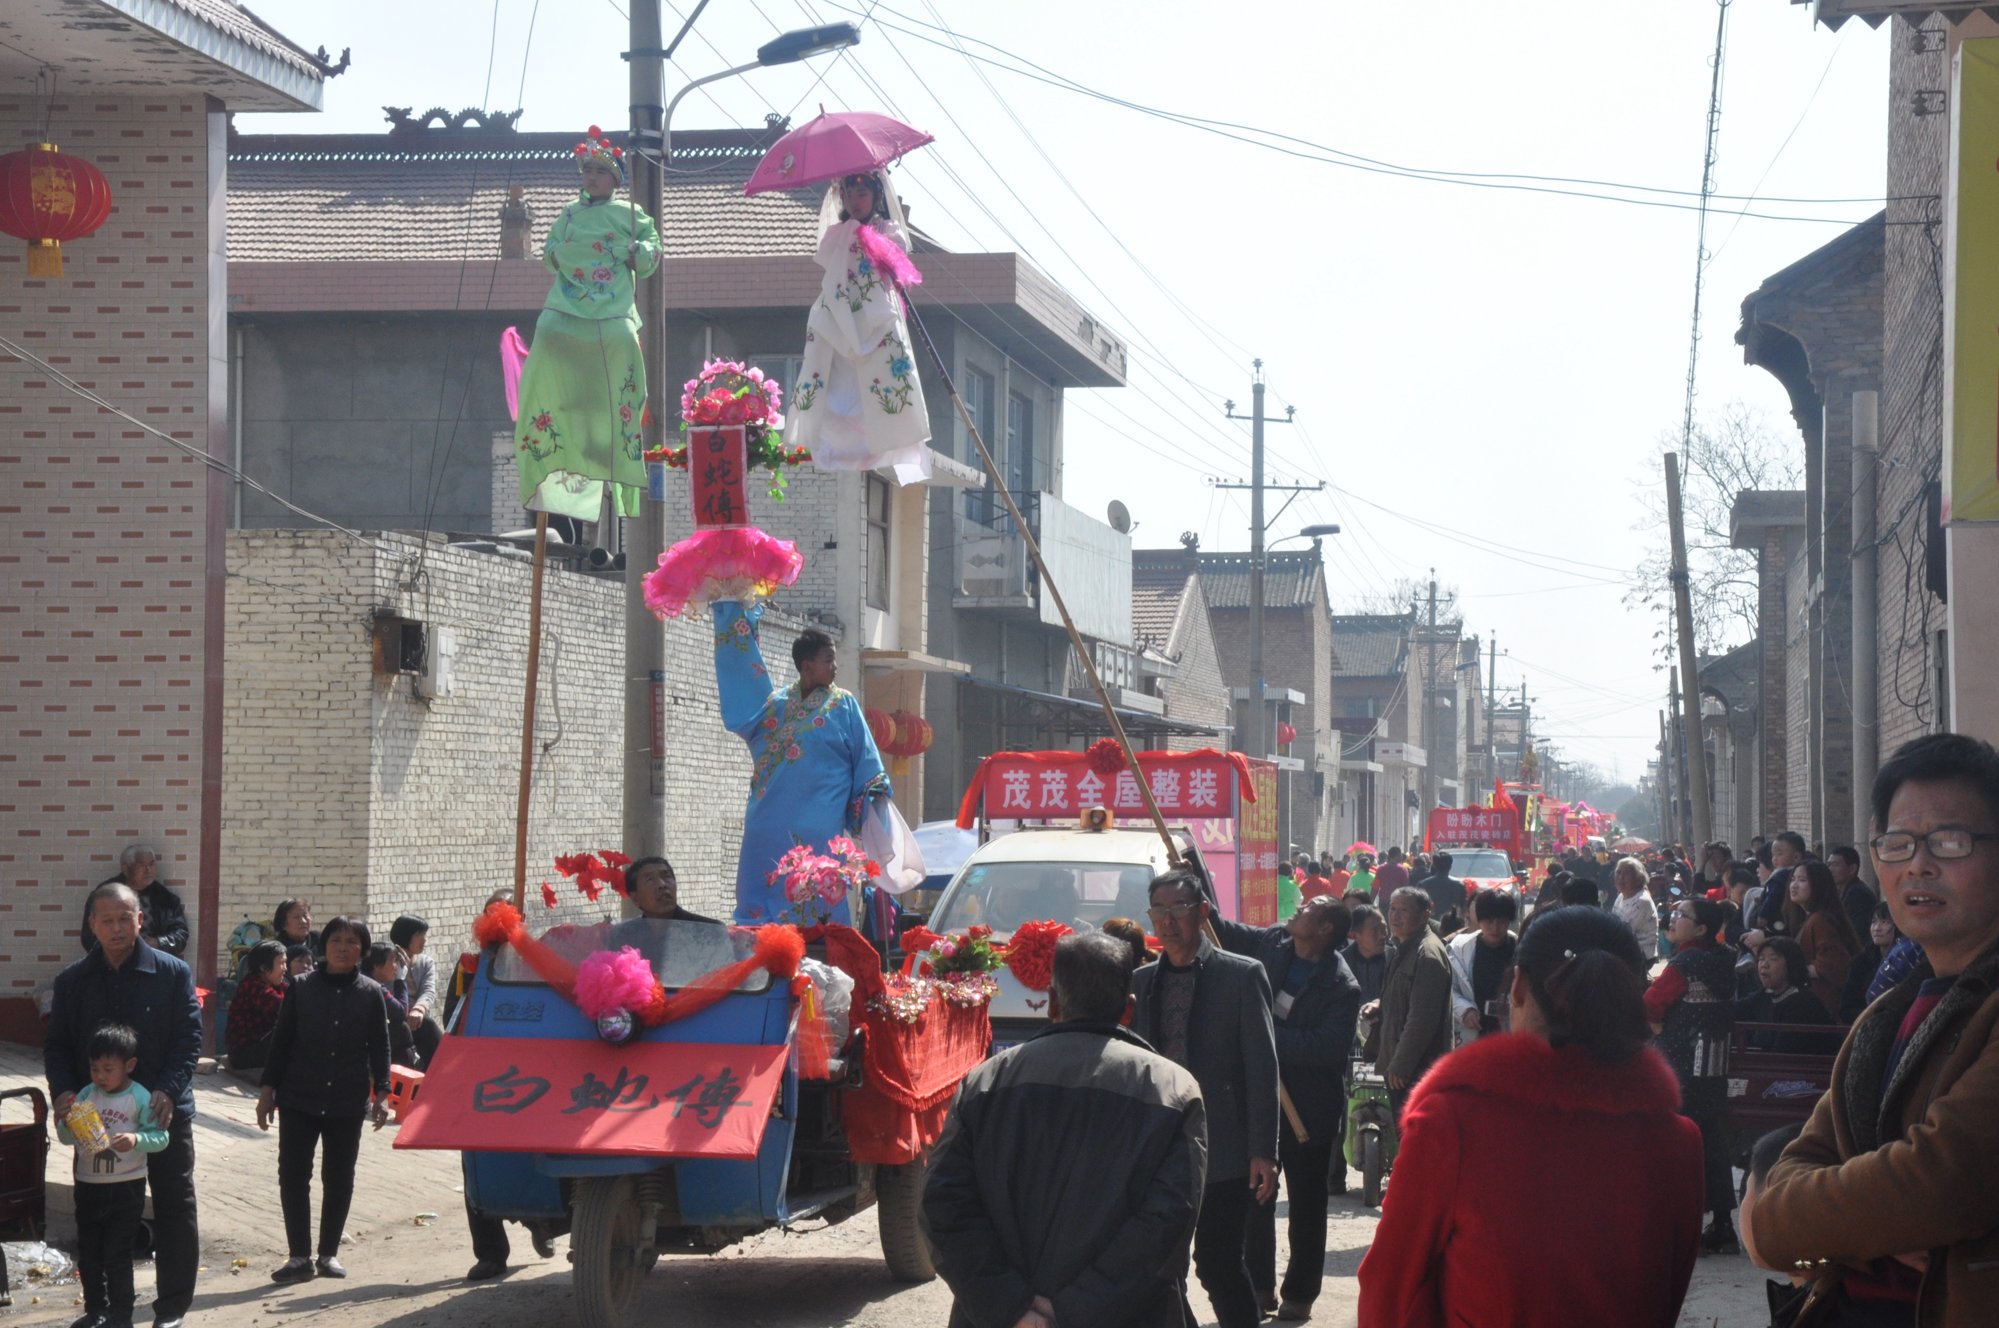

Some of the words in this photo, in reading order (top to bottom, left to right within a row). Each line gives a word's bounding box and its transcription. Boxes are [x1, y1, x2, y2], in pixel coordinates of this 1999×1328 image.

[1002, 768, 1218, 809] 茂茂全屋整装
[1447, 813, 1502, 827] 盼盼木门
